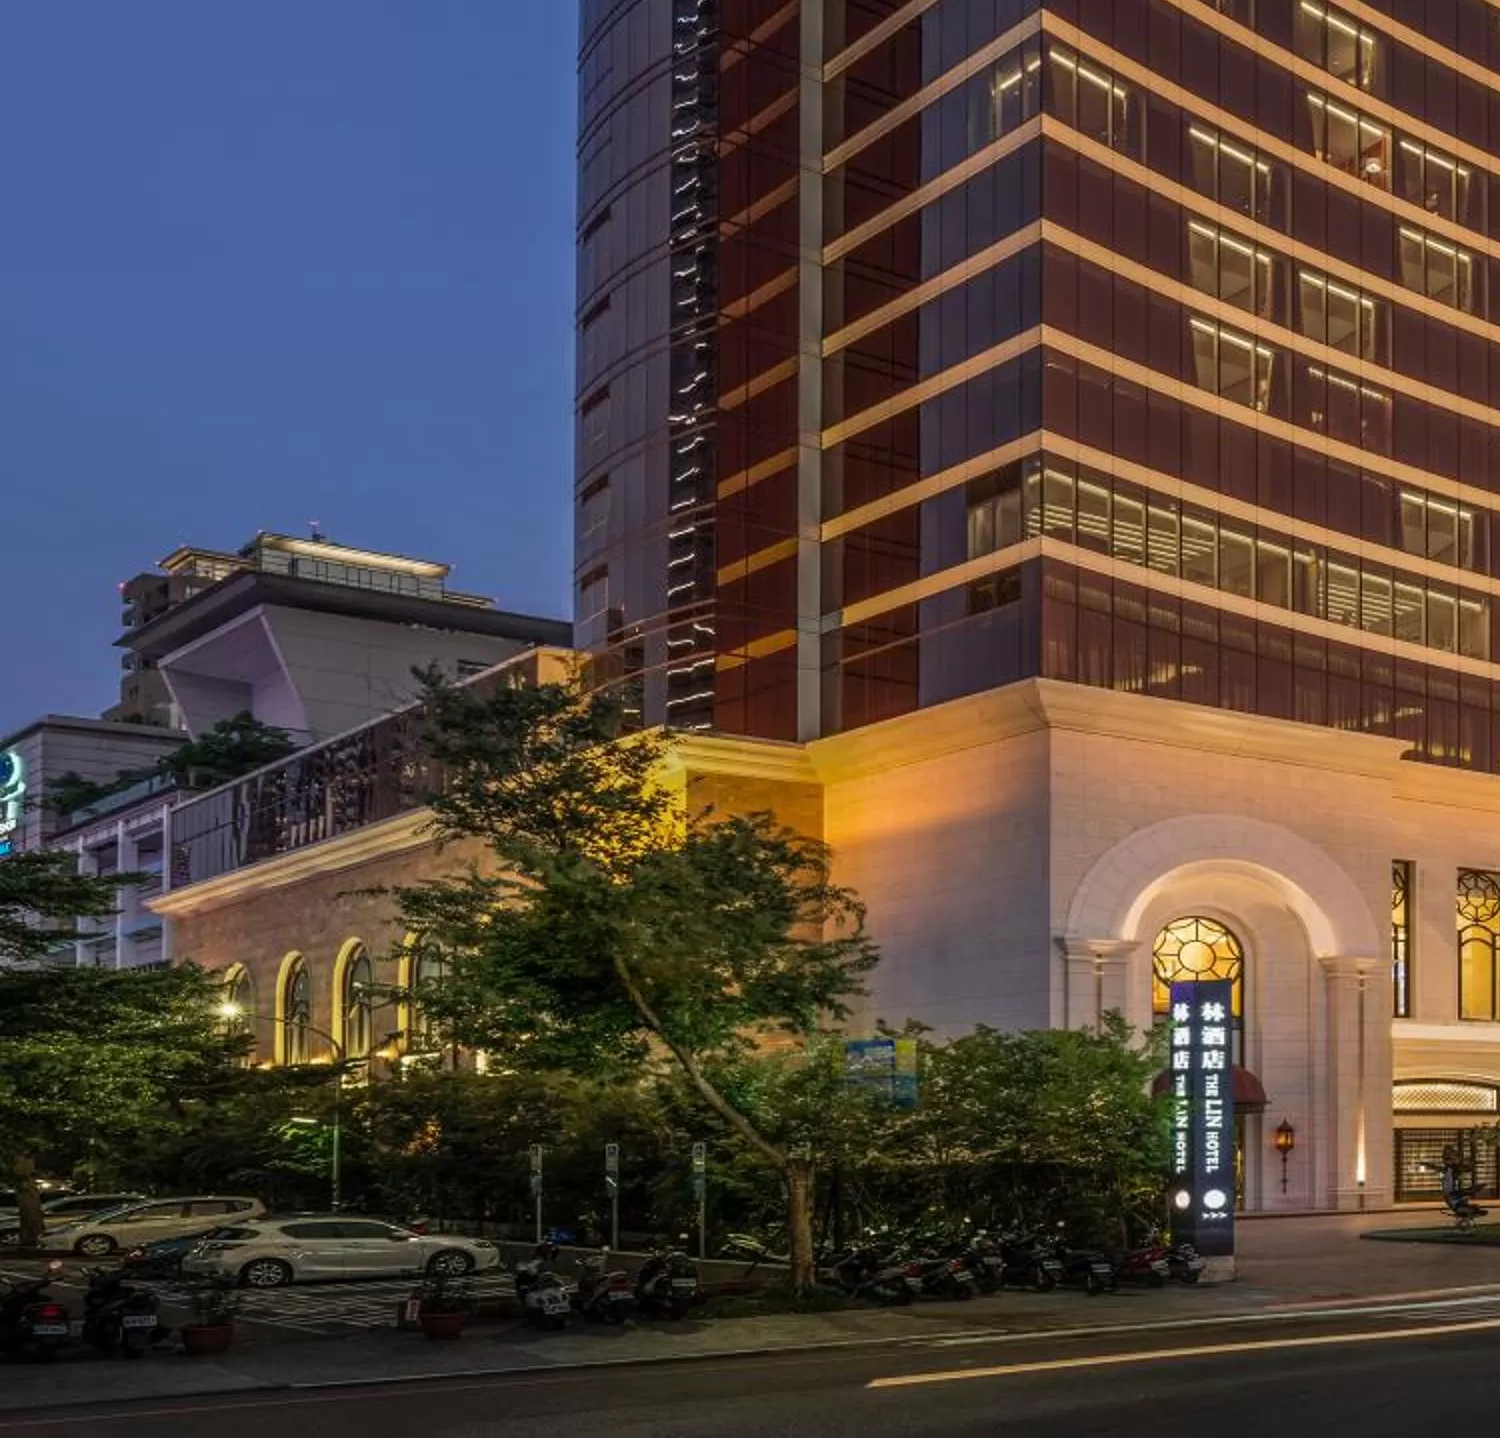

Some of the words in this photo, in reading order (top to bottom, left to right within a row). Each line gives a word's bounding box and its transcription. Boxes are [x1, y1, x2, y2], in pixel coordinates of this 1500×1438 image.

[1201, 1002, 1226, 1070] 林酒店
[1205, 1074, 1219, 1097] THE
[1205, 1099, 1223, 1128] LIN
[1175, 1132, 1187, 1175] HOTEL
[1205, 1131, 1220, 1174] HOTEL
